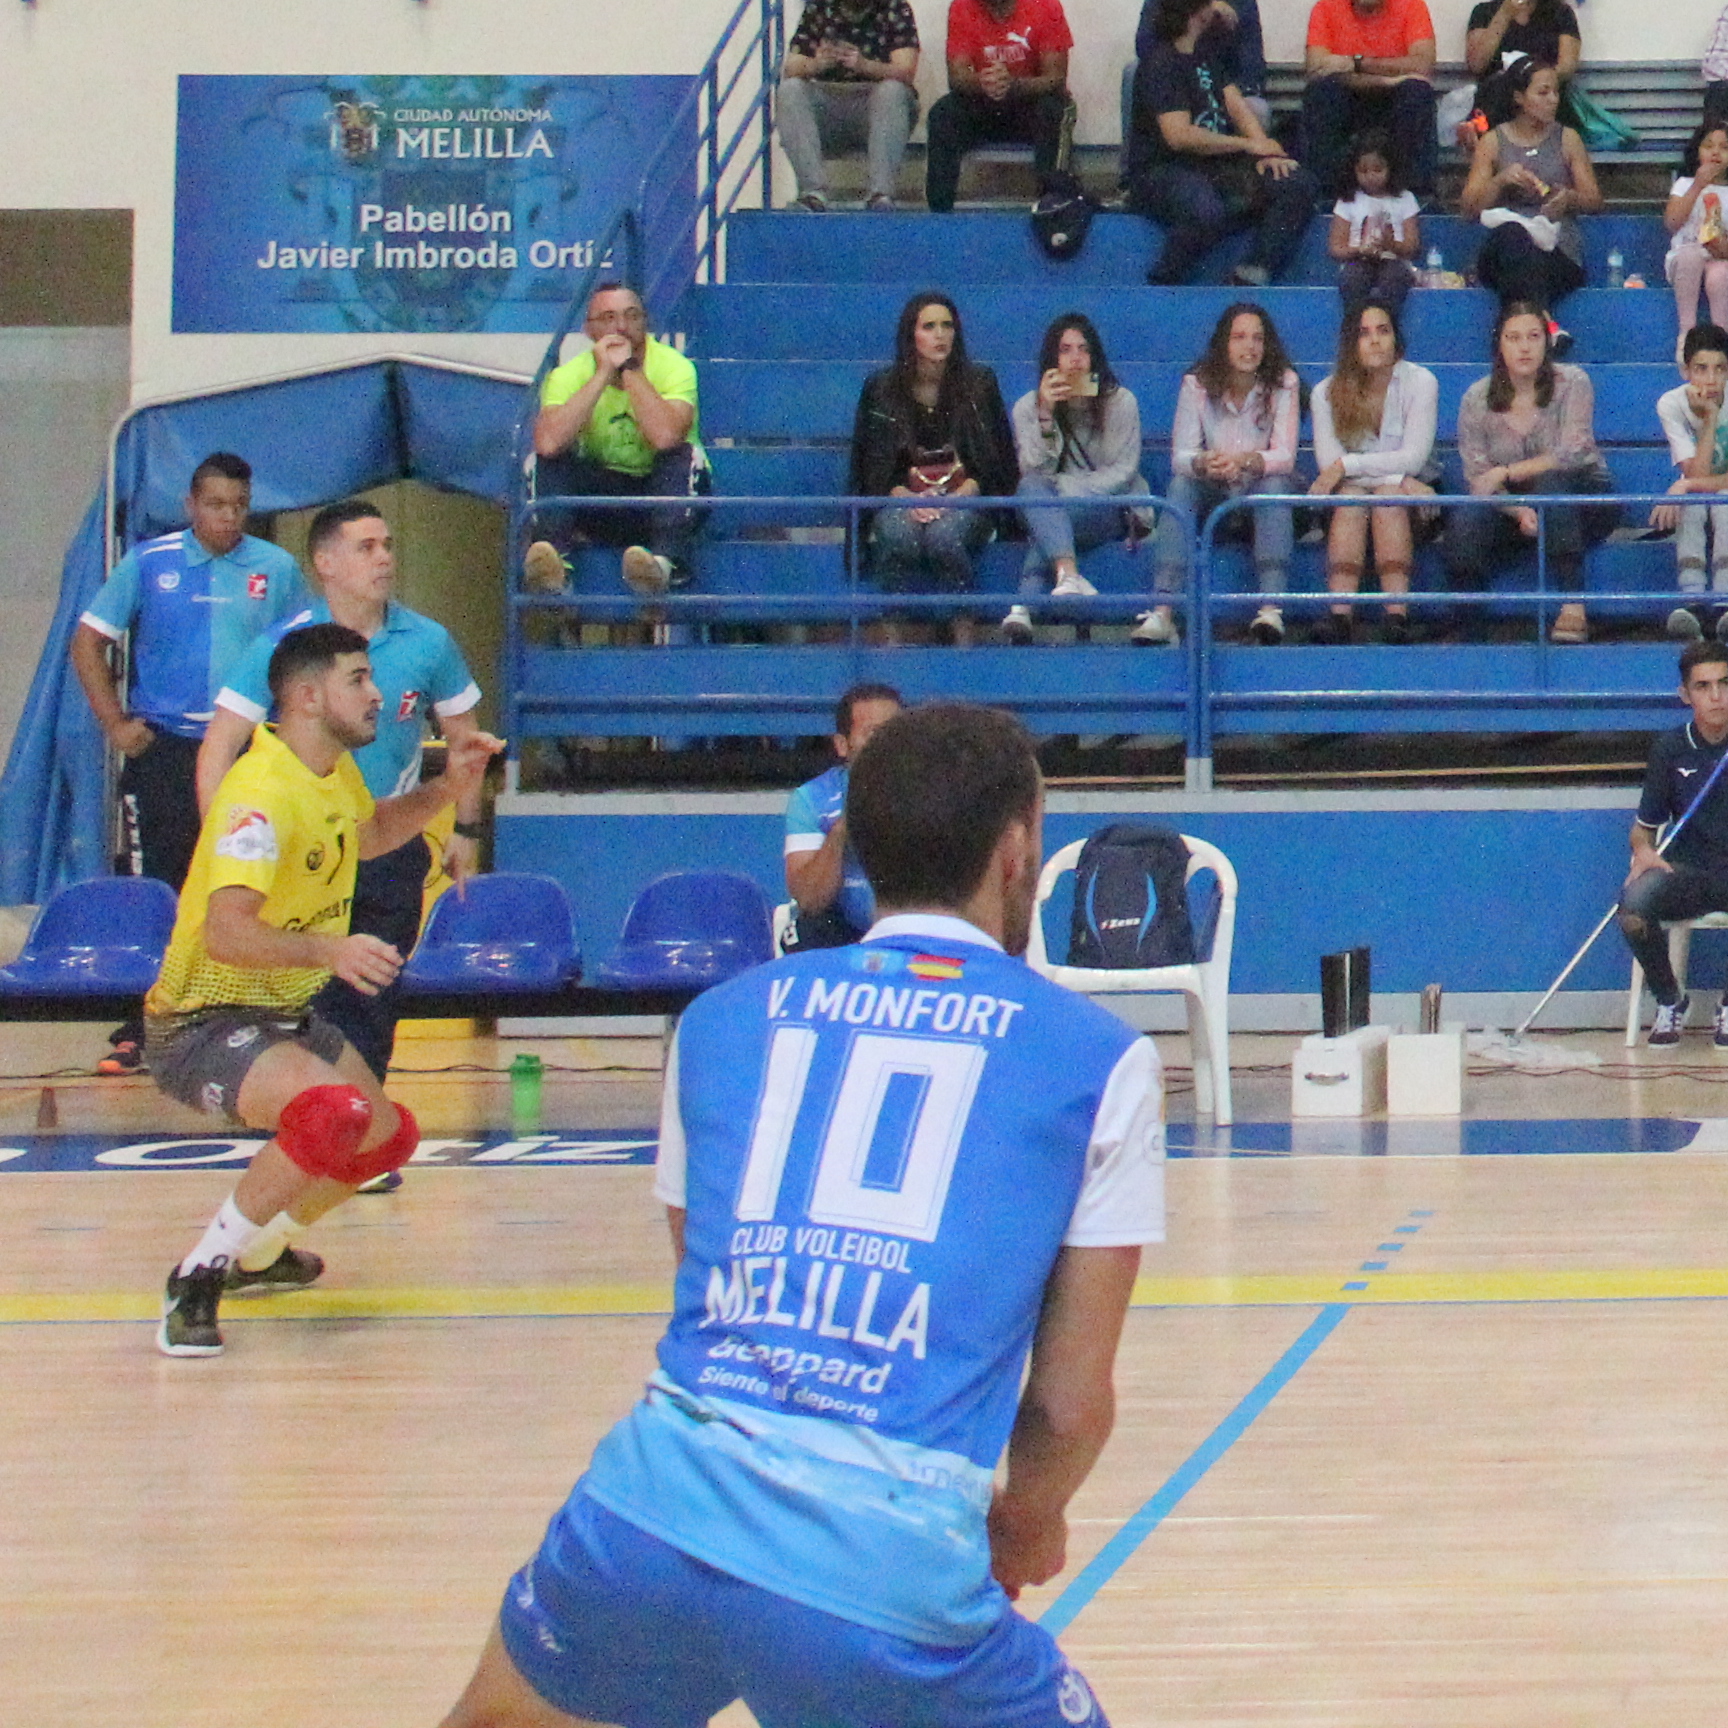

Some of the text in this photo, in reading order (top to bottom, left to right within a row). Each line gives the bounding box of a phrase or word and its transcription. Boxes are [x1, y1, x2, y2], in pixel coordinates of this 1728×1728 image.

[393, 108, 453, 123] CIUDAD
[396, 127, 555, 160] MELILLA
[360, 202, 512, 234] Pabellón
[257, 240, 364, 270] Javier
[374, 239, 519, 270] Imbroda
[766, 976, 1024, 1039] V. MONFORT
[734, 1022, 990, 1243] 10
[729, 1226, 912, 1276] CLUB VOLEIBOL
[702, 1264, 933, 1360] MELILLA
[697, 1365, 770, 1399] Siente
[792, 1387, 880, 1424] deporte
